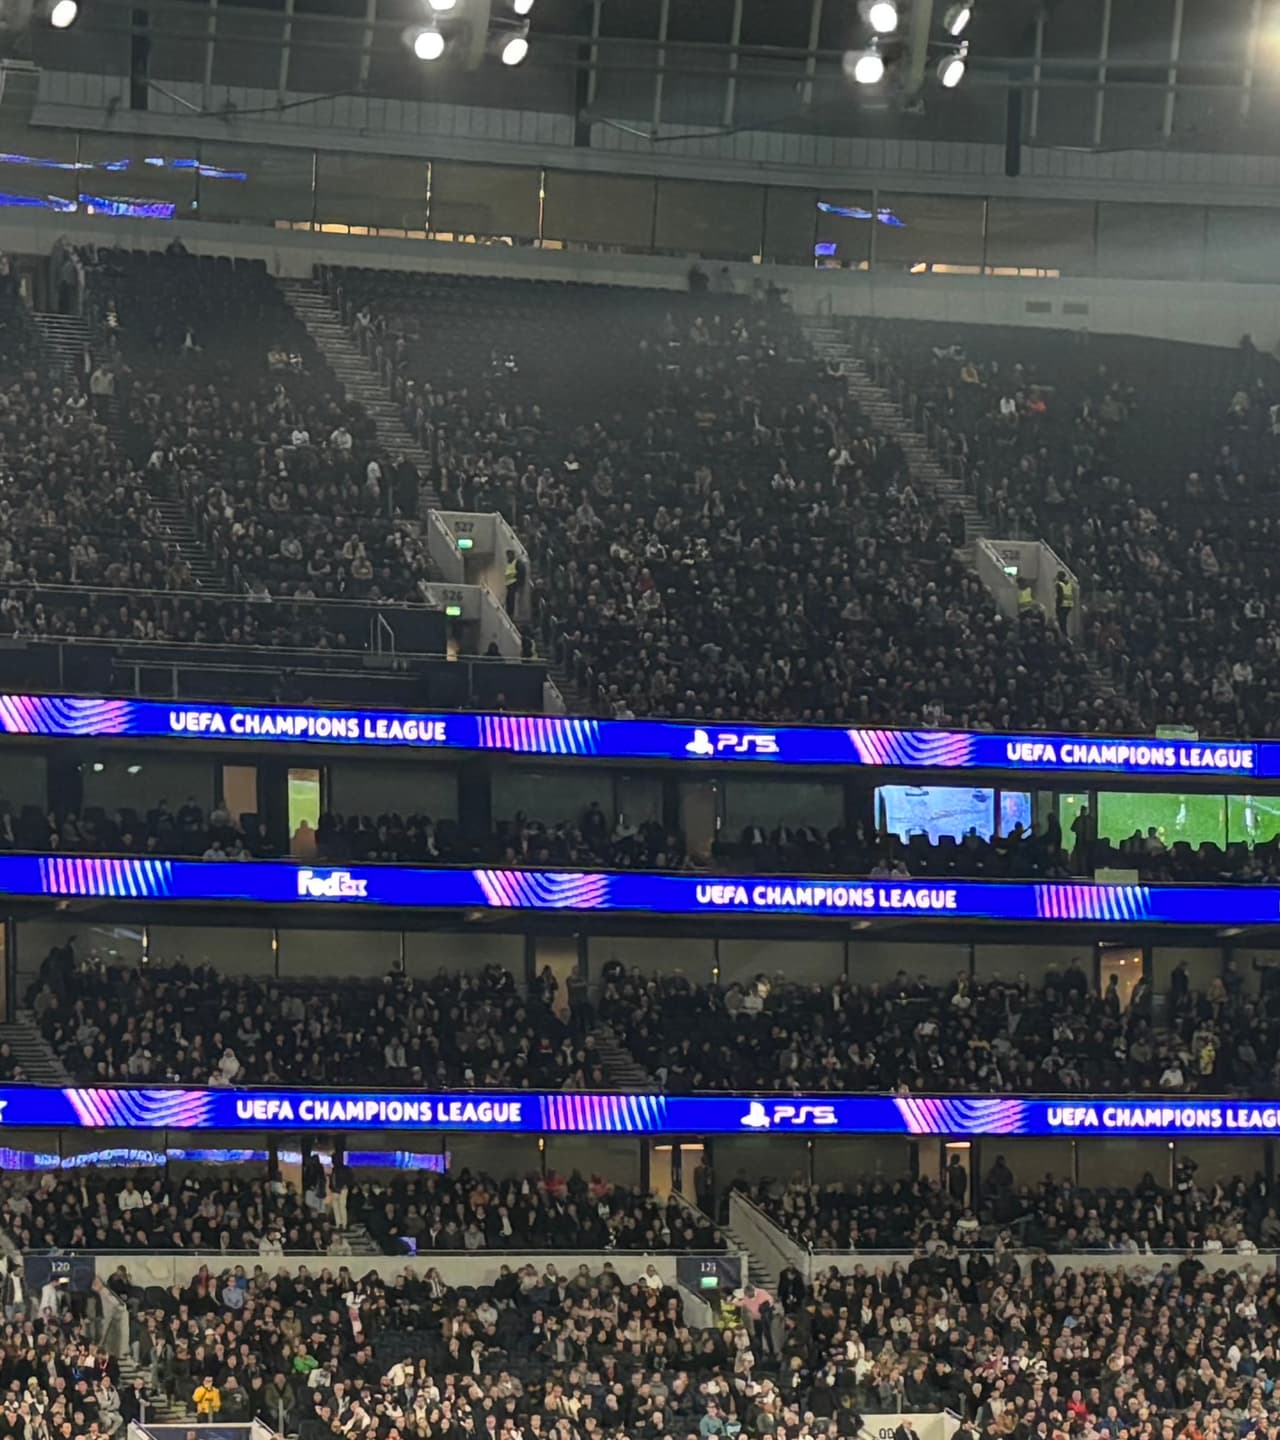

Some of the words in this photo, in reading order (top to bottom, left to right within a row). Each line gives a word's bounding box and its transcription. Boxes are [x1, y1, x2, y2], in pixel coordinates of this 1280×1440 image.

[170, 712, 226, 733] UEFA
[230, 713, 359, 738] CHAMPIONS
[364, 719, 446, 740] LEAGUE
[717, 734, 780, 752] PS5
[1007, 743, 1056, 762] UEFA
[1060, 744, 1176, 766] CHAMPIONS
[1180, 748, 1253, 768] LEAGUE
[298, 870, 368, 896] FedEx
[696, 885, 748, 904] UEFA
[753, 886, 875, 907] CHAMPIONS
[879, 889, 956, 908] LEAGUE
[237, 1100, 294, 1120] UEFA
[299, 1100, 432, 1121] CHAMPIONS
[437, 1102, 521, 1122] LEAGUE
[773, 1105, 838, 1125] PS5
[1048, 1107, 1098, 1126] UEFA
[1103, 1107, 1222, 1128] CHAMPIONS
